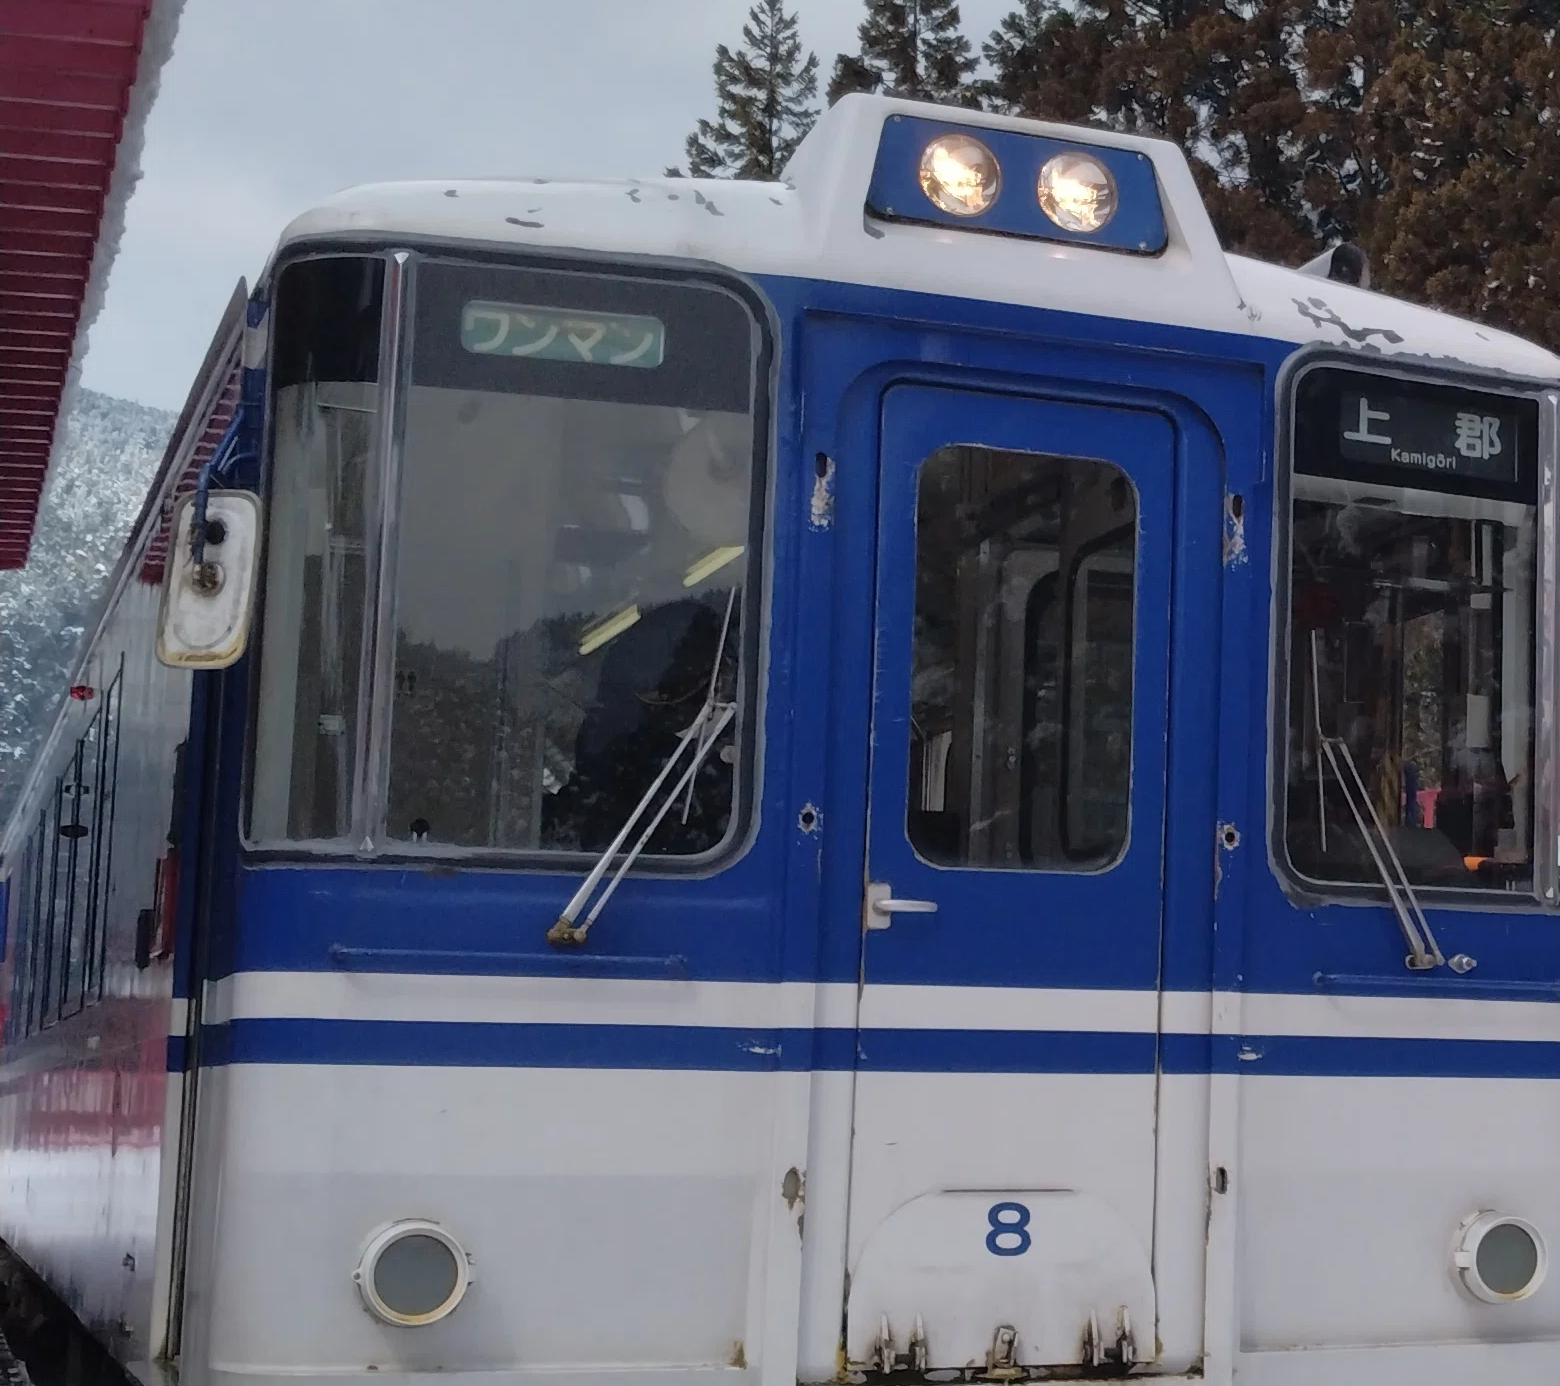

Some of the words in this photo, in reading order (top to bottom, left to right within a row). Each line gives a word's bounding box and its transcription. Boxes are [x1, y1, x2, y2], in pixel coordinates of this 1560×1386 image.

[464, 311, 654, 364] ワンマン
[1342, 396, 1502, 460] 上郡
[985, 1201, 1032, 1257] 8
